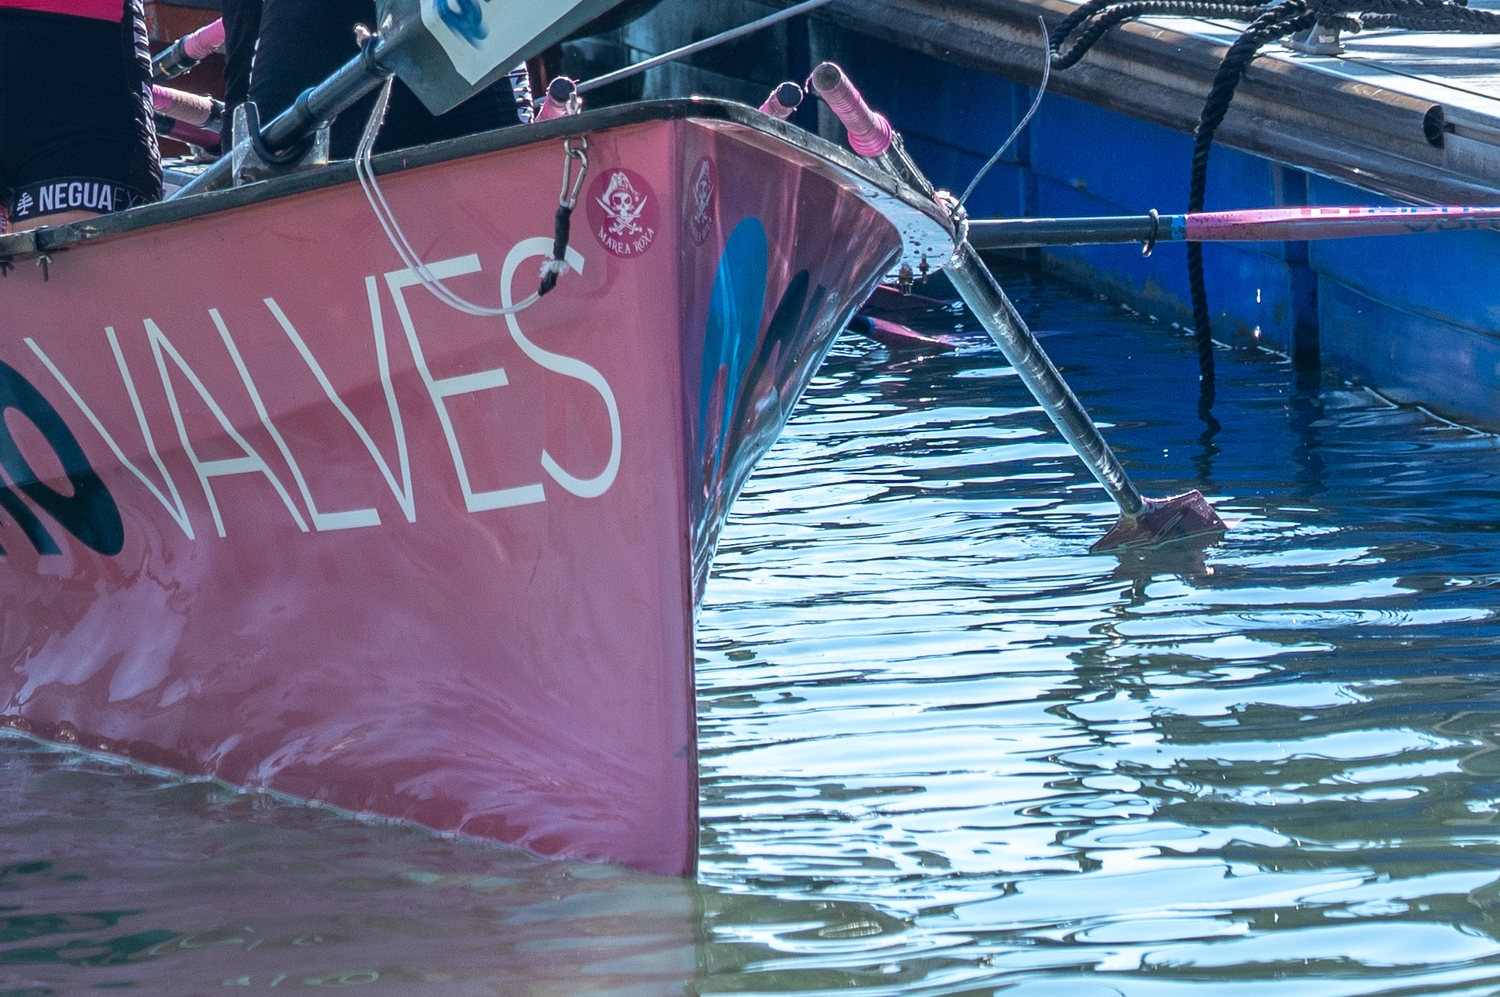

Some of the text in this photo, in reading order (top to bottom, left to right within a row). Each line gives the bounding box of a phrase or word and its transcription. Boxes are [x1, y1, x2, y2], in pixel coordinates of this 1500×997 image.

[39, 181, 113, 213] NEGUA
[597, 225, 632, 255] MAREA
[23, 236, 623, 541] VALVES
